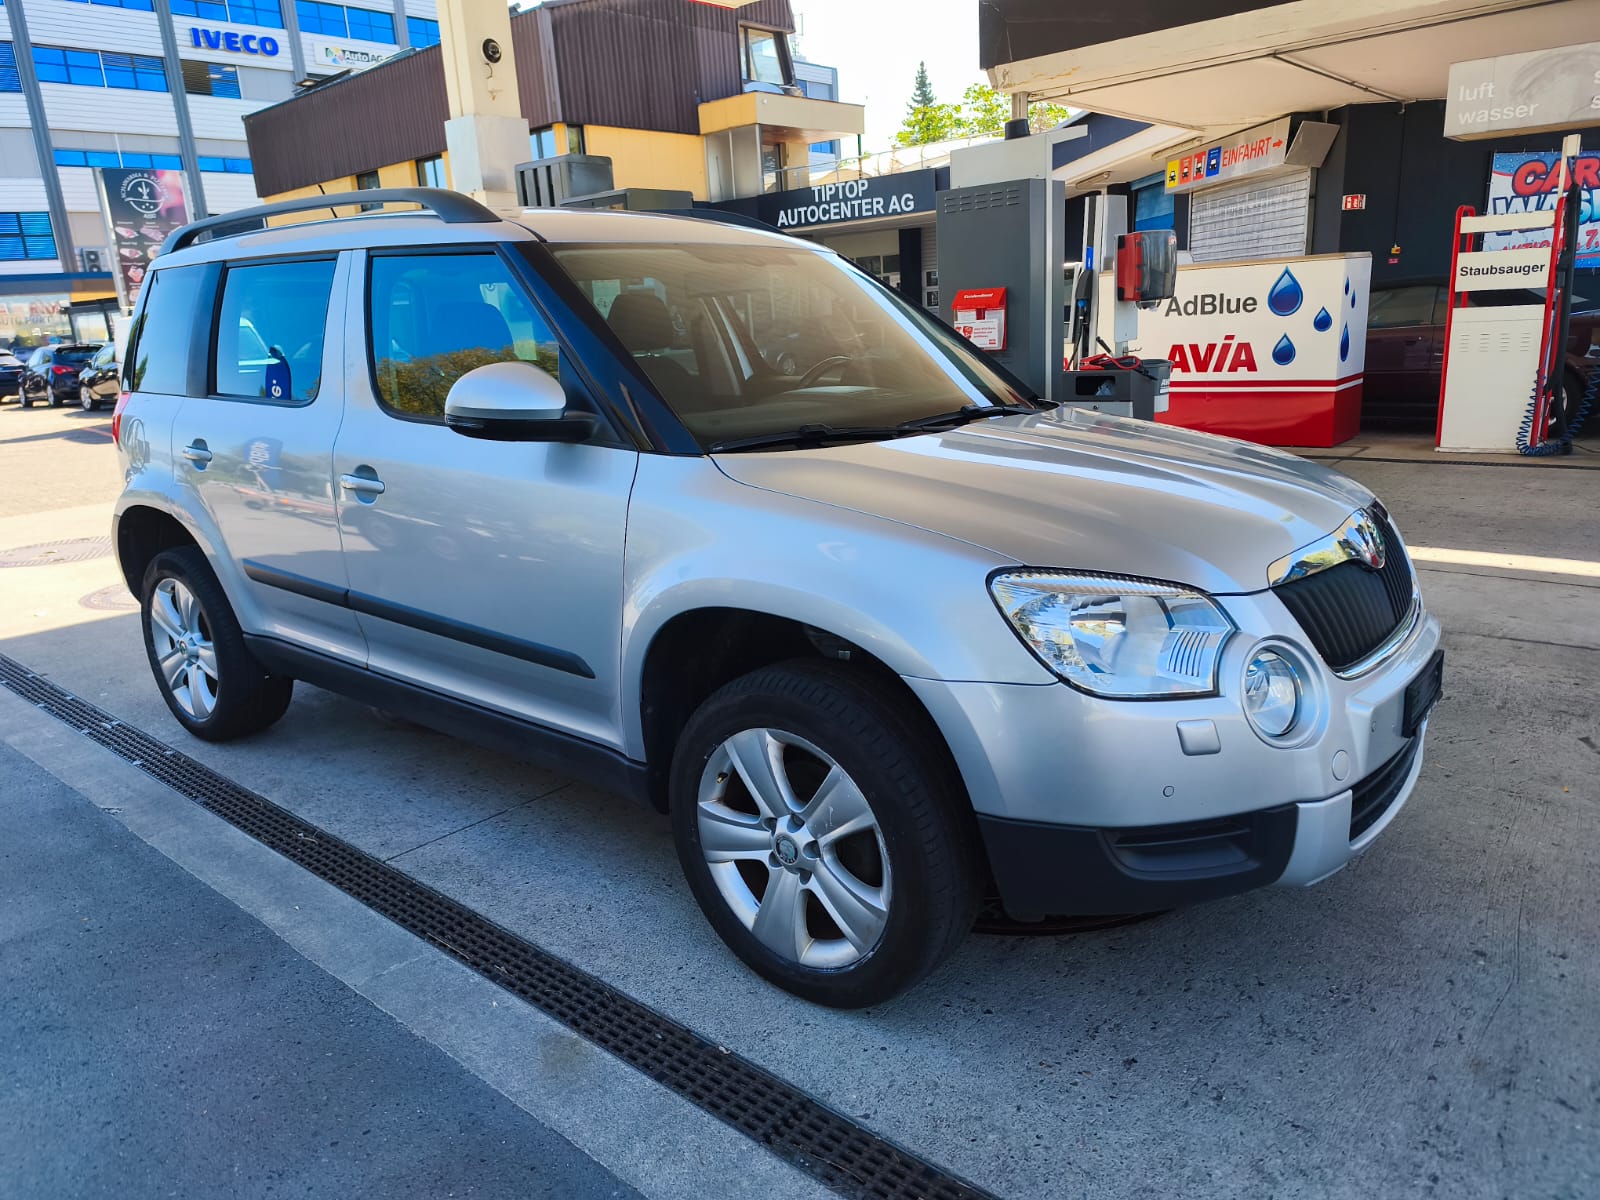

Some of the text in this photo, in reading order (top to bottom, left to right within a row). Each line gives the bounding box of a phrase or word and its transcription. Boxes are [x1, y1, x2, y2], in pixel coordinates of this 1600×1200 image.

[191, 28, 279, 57] IVECO
[344, 50, 369, 62] Auto
[1459, 82, 1495, 101] luft
[1458, 103, 1539, 125] wasser
[1222, 136, 1272, 168] EINFAHRT
[1513, 157, 1600, 196] CAR
[811, 180, 868, 203] TIPTOP
[777, 193, 915, 227] AUTOCENTER AG
[1493, 190, 1600, 236] WAS
[1460, 263, 1546, 277] Staubsauger
[1164, 293, 1258, 317] AdBlue
